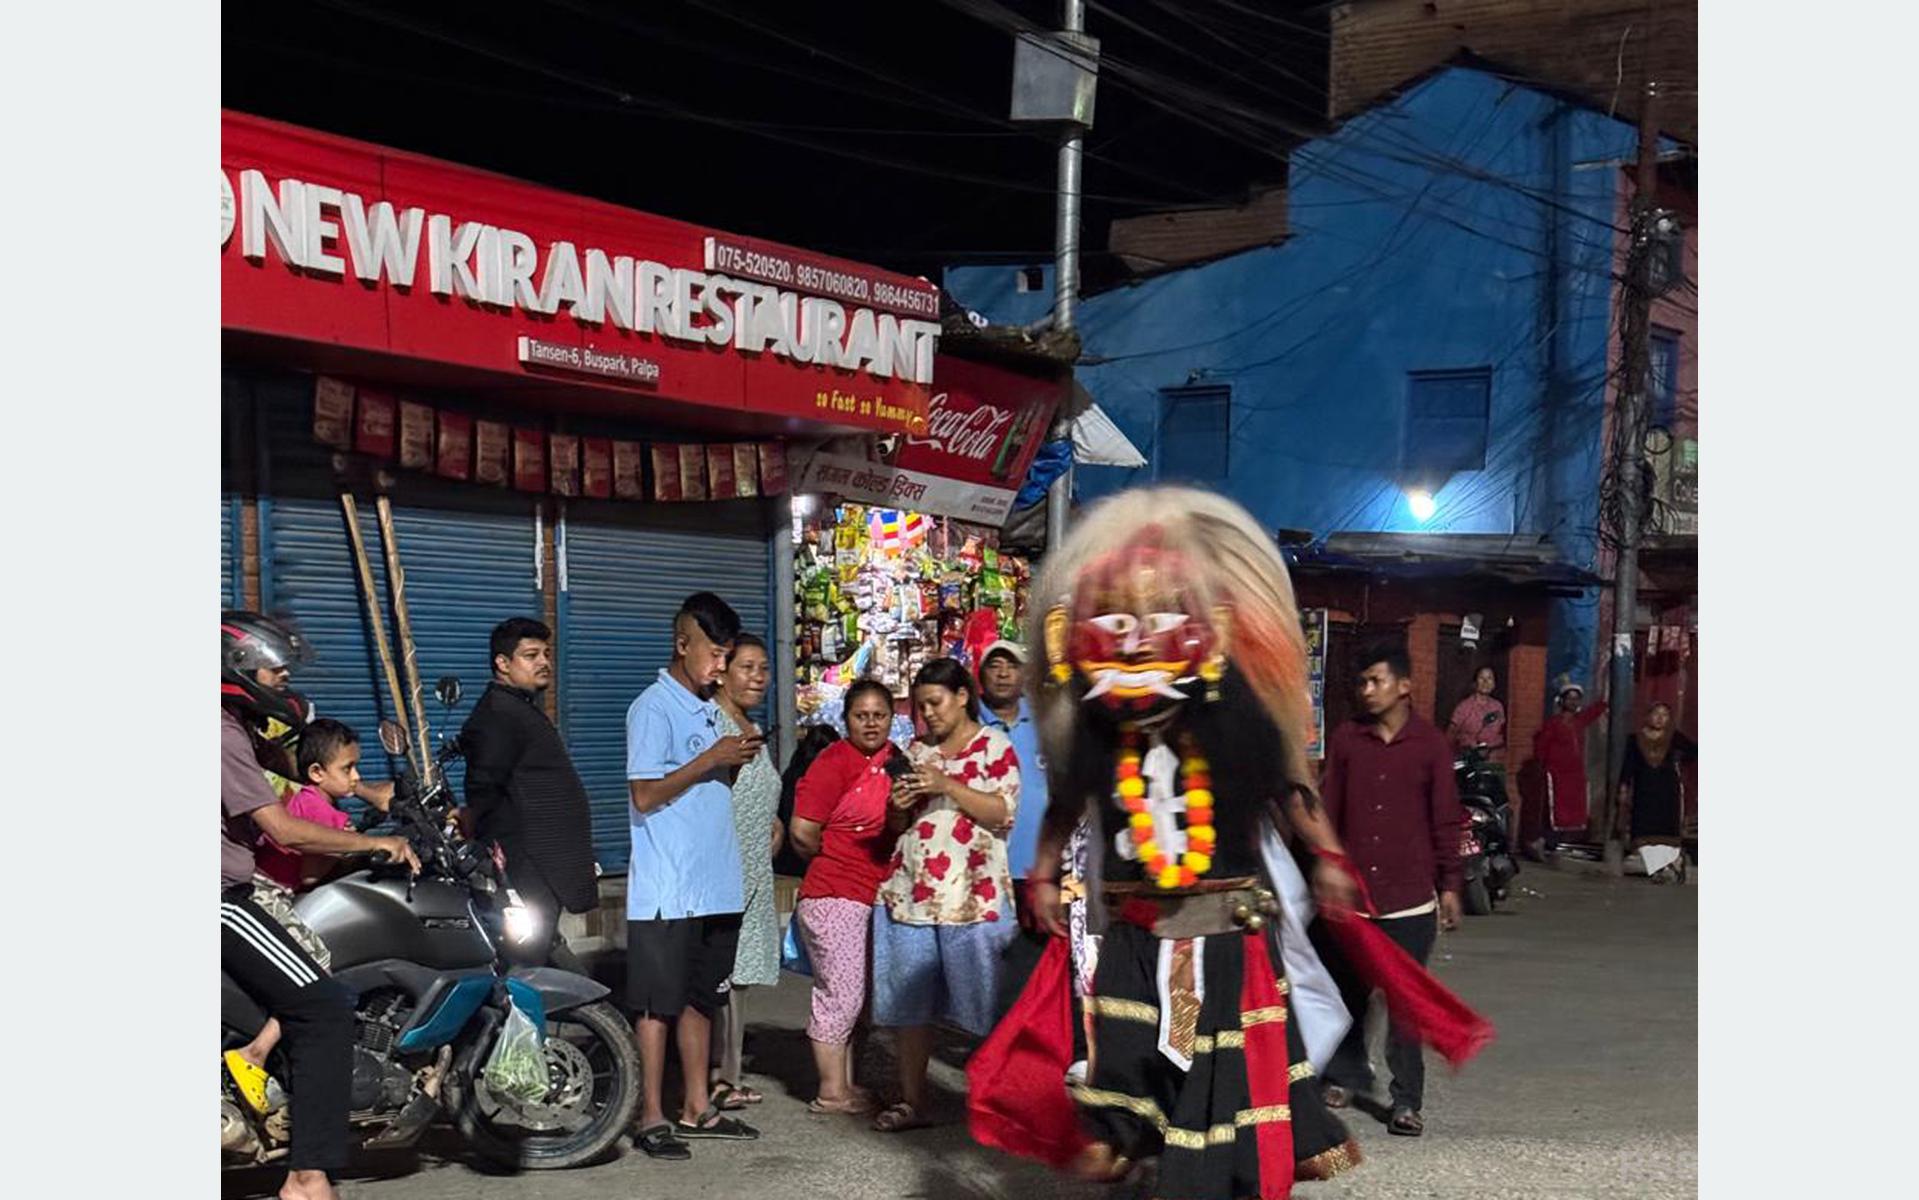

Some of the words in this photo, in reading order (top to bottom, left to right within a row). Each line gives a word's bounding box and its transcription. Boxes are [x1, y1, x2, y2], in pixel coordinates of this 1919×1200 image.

[240, 169, 425, 286] NEW
[428, 213, 635, 328] KIRAN
[636, 259, 942, 384] RESTAURANT
[530, 339, 582, 368] Tansen-6,
[584, 349, 629, 375] Buspark,
[631, 357, 660, 380] Palpa
[831, 389, 856, 413] Fast
